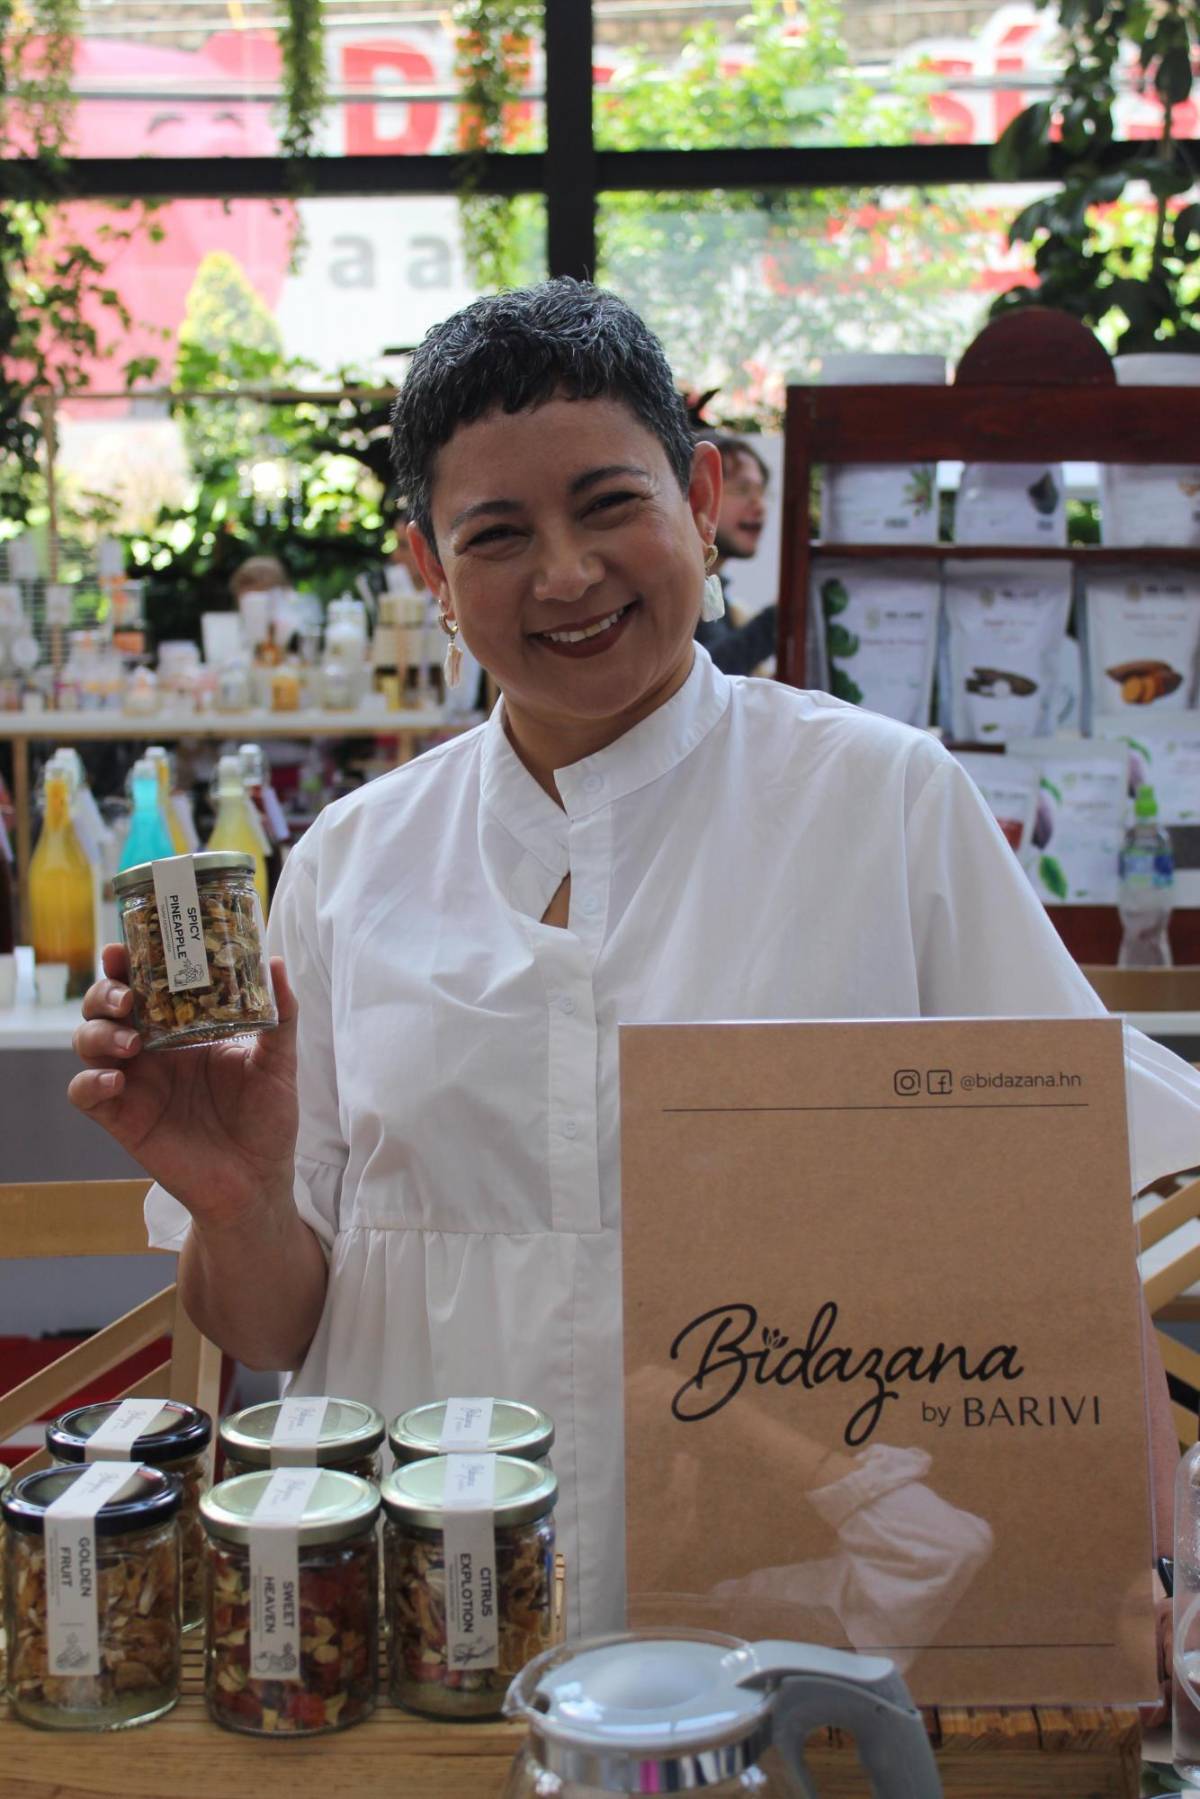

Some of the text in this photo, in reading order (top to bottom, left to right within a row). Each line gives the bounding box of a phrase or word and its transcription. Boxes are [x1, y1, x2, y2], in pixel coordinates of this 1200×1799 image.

[169, 894, 187, 960] PINEAPPLE
[187, 907, 201, 941] SPICY
[959, 1071, 1082, 1092] @bidazana.hn
[669, 1301, 1025, 1447] Bidazana
[921, 1395, 1101, 1428] by BARIVI
[60, 1546, 72, 1588] FRUIT
[78, 1536, 92, 1598] GOLDEN
[480, 1567, 493, 1618] CITRUS
[264, 1576, 276, 1634] HEAVEN
[282, 1580, 295, 1629] SWEET
[460, 1552, 475, 1634] EXPLOTION
